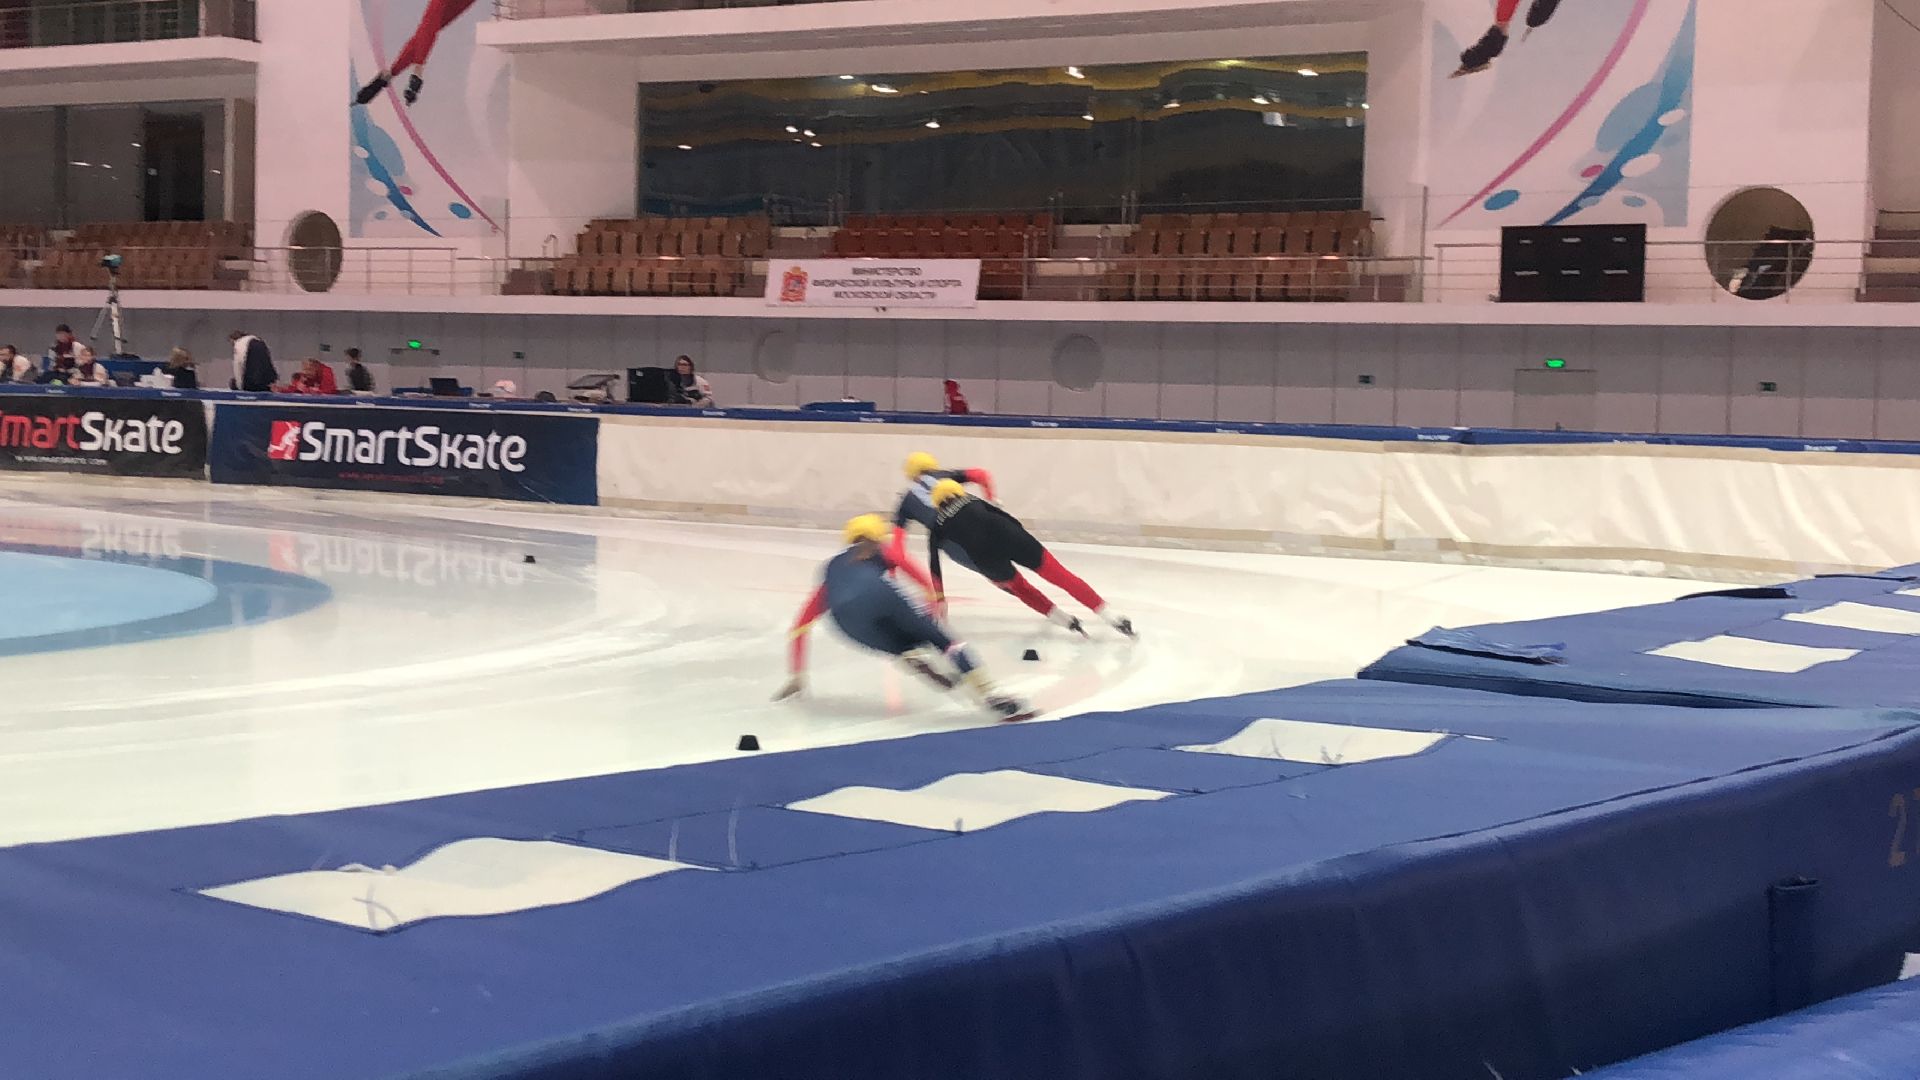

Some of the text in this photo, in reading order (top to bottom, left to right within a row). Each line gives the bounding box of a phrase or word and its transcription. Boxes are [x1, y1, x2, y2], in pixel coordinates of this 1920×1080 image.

[0, 410, 184, 454] martSkate
[300, 421, 528, 472] SmartSkate
[1888, 786, 1920, 867] 2
